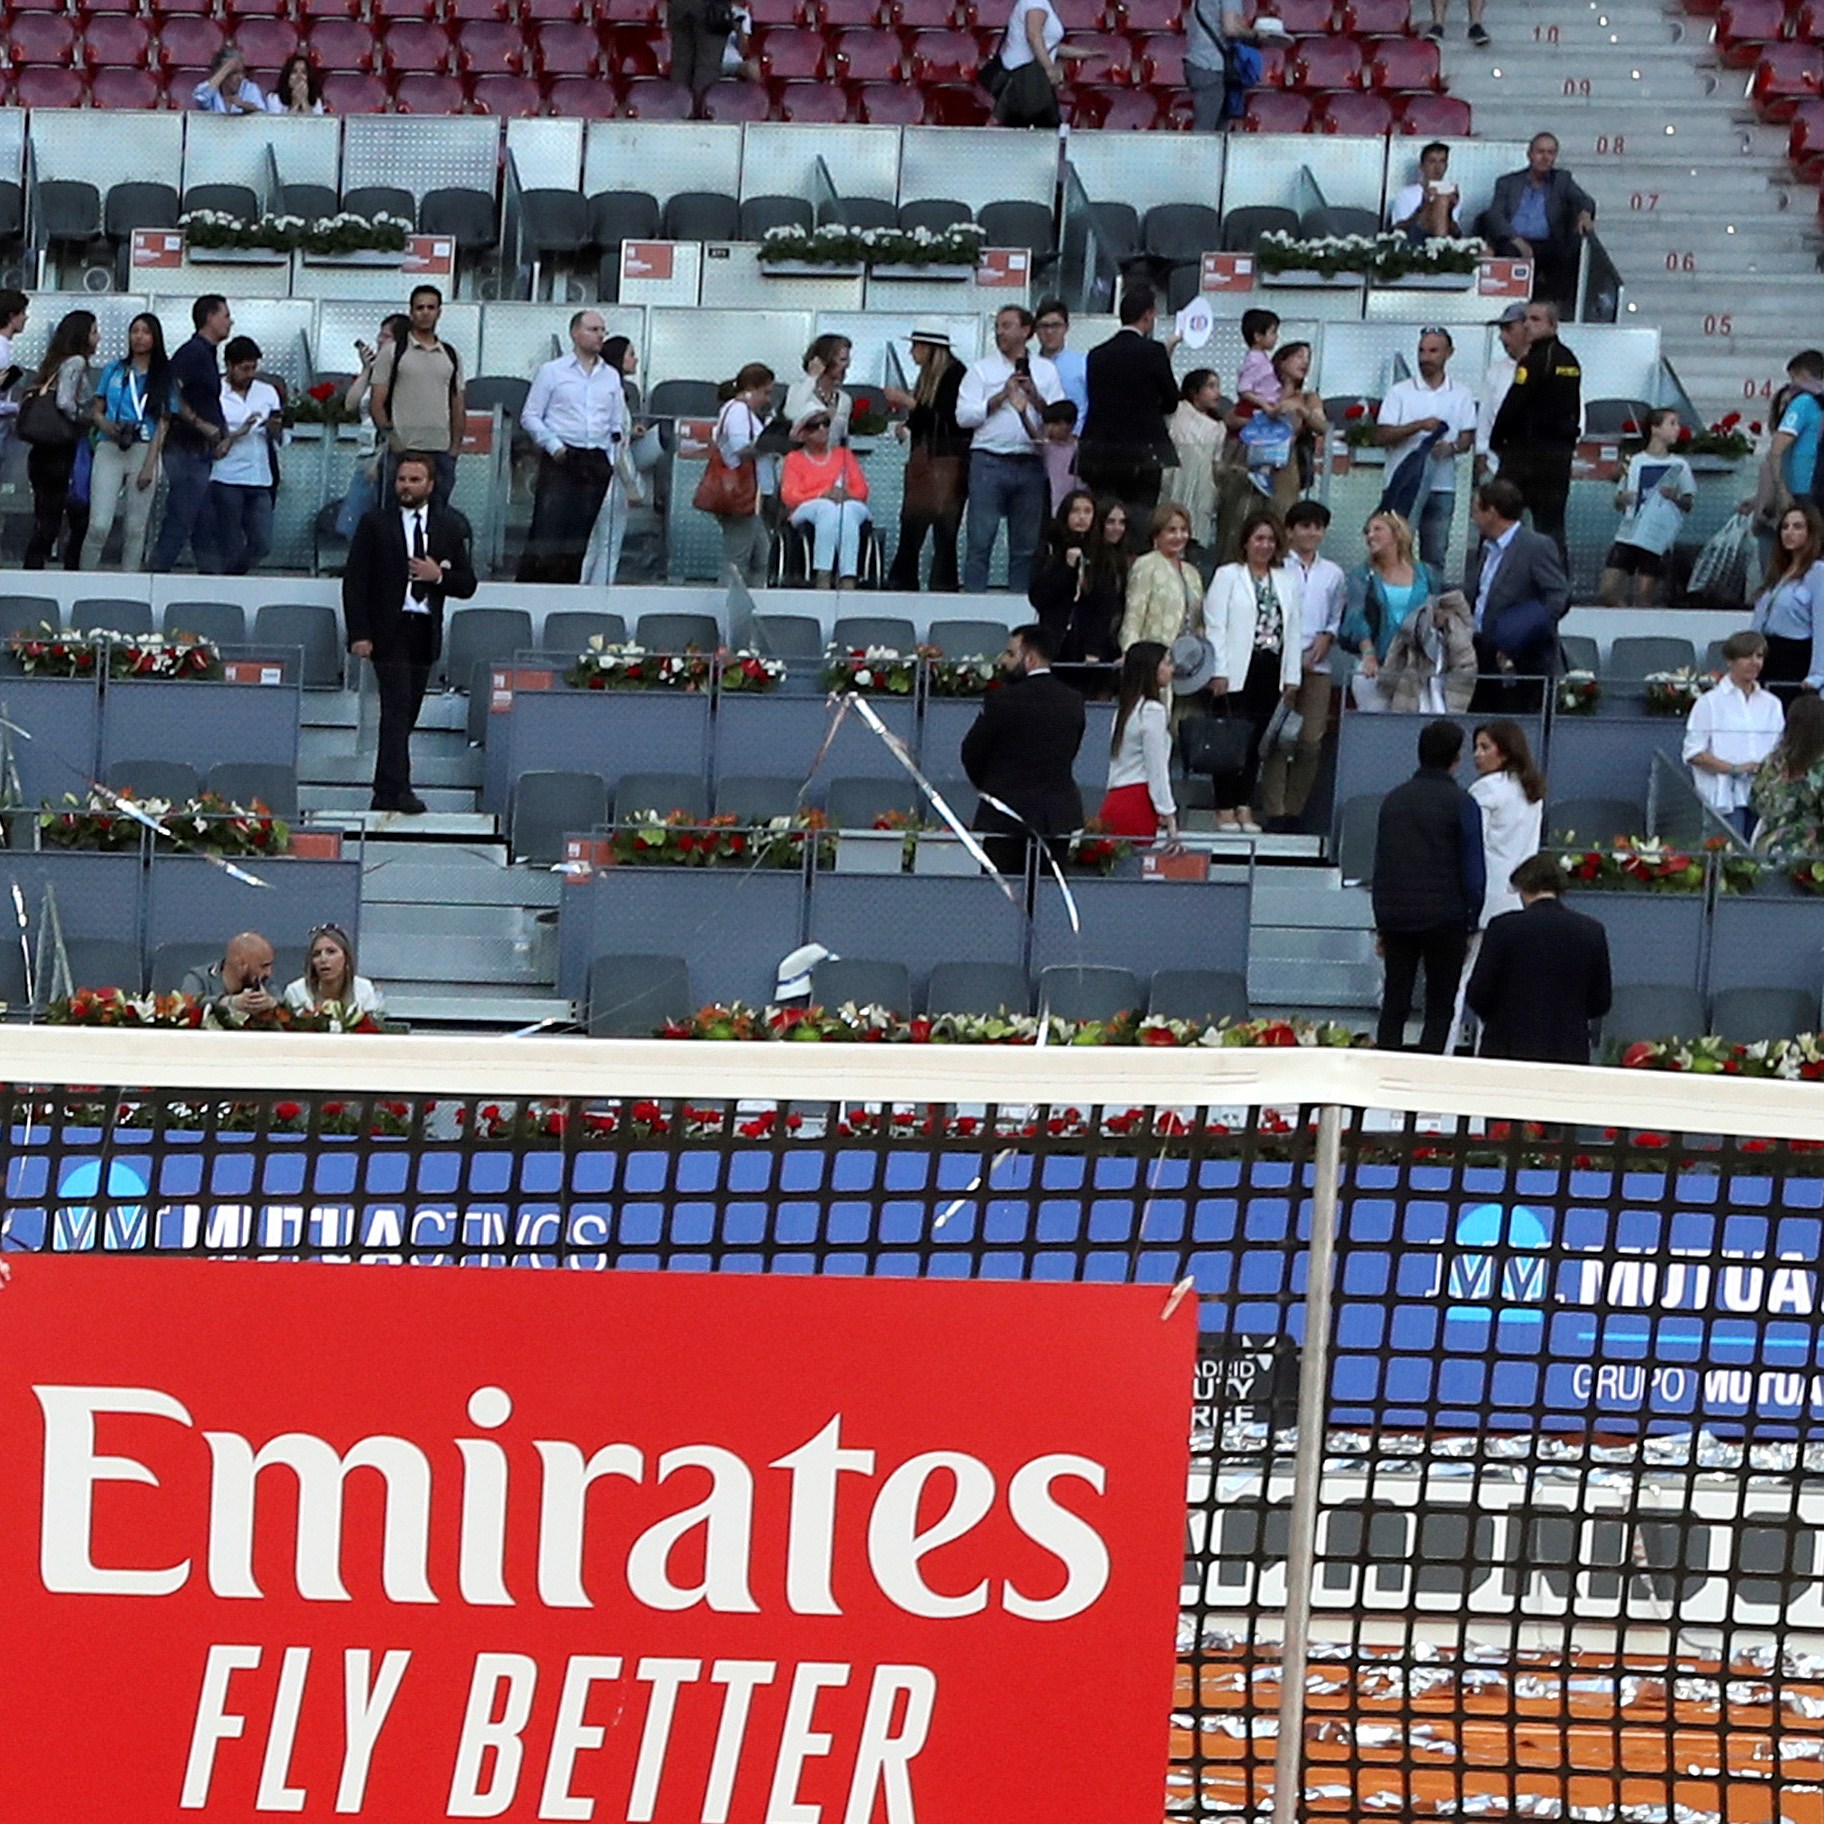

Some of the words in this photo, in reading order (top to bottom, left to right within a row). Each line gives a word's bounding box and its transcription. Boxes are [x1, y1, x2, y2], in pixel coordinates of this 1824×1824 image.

[1563, 77, 1591, 96] 09
[1596, 135, 1625, 154] 08
[1630, 193, 1659, 211] 07
[1665, 251, 1694, 271] 06
[1704, 315, 1732, 335] 05
[1743, 380, 1772, 399] 04
[1193, 1378, 1254, 1400] UTY
[32, 1385, 1109, 1621] Emirates
[180, 1645, 412, 1813] FLY
